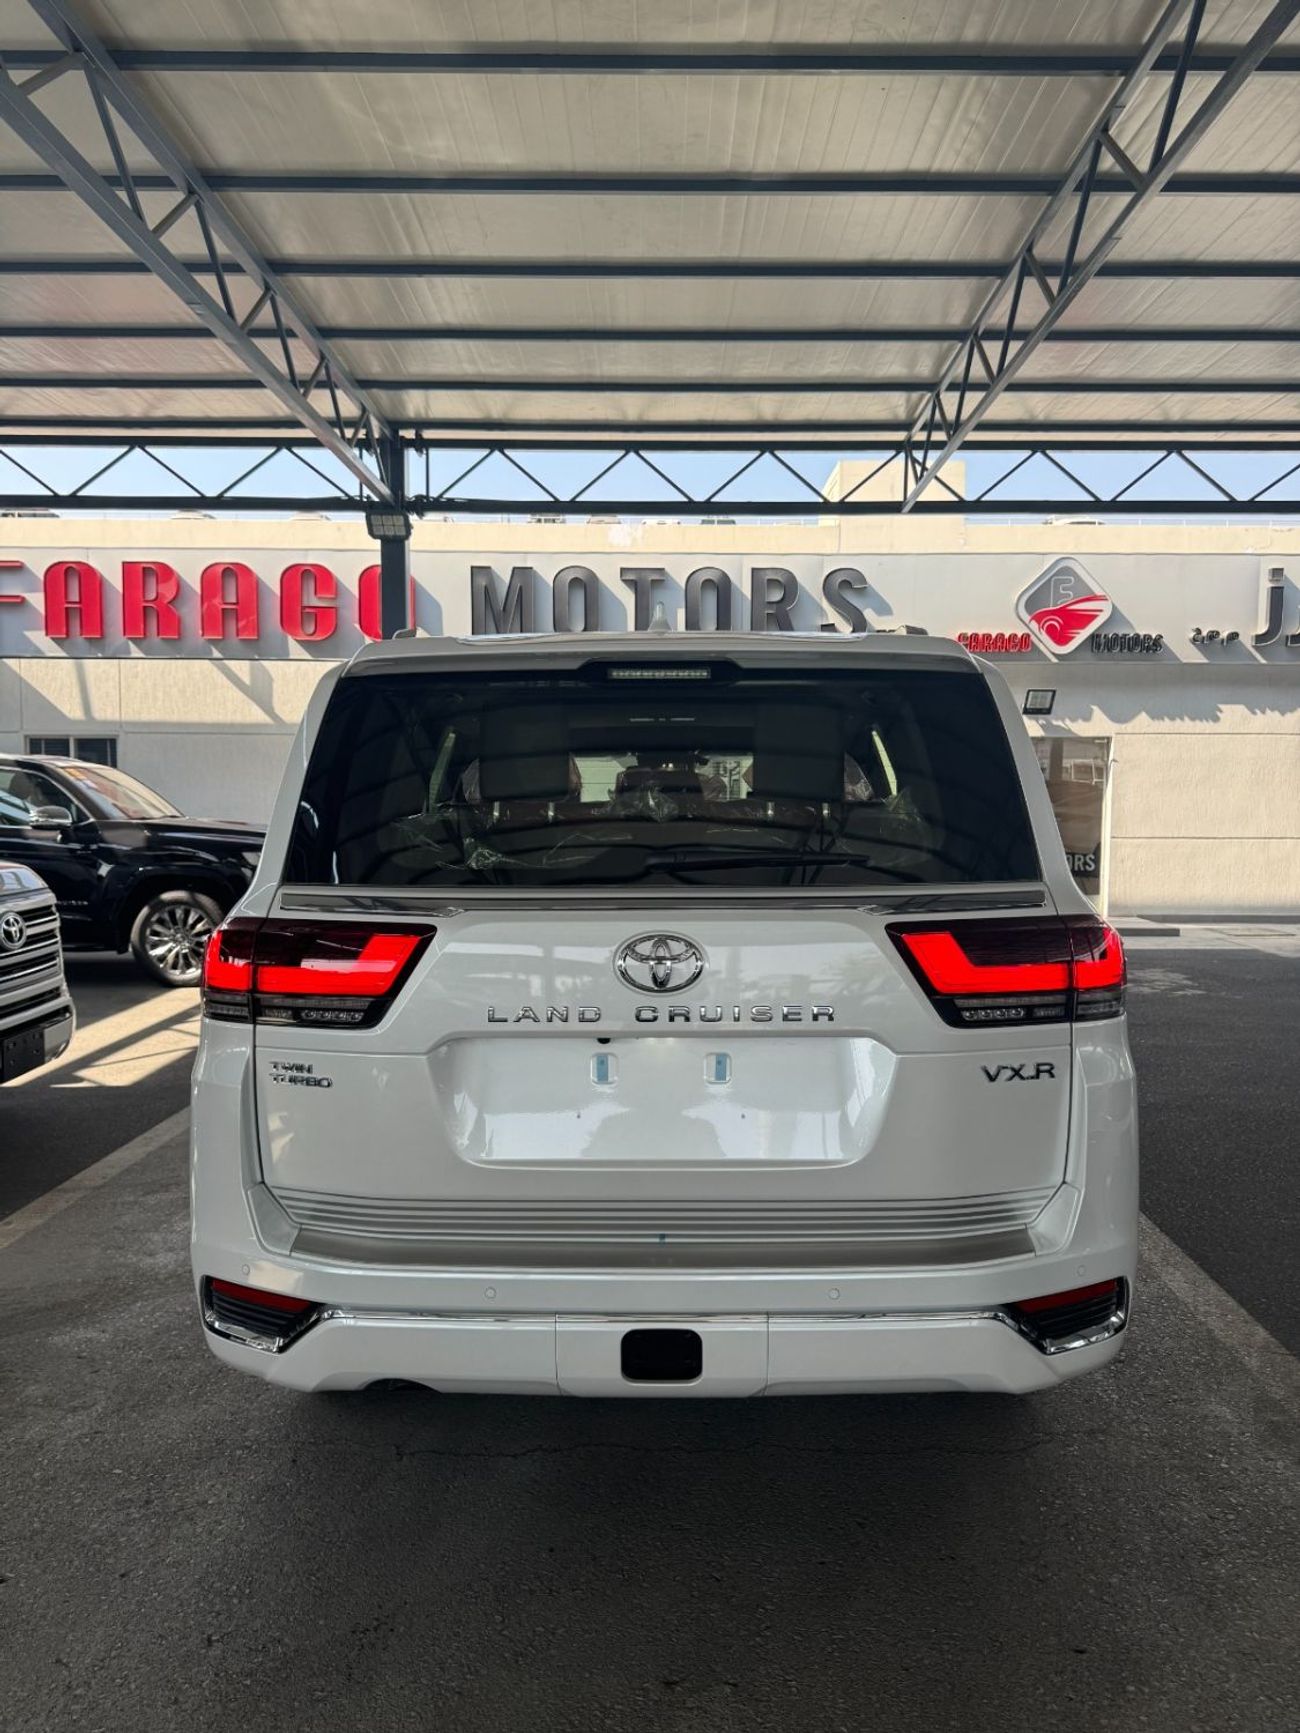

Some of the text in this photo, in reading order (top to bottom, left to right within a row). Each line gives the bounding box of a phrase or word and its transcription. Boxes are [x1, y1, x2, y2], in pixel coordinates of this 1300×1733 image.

[471, 566, 868, 634] MOTORS
[1091, 632, 1163, 653] MOTORS
[487, 1005, 836, 1023] LAND CRUISER
